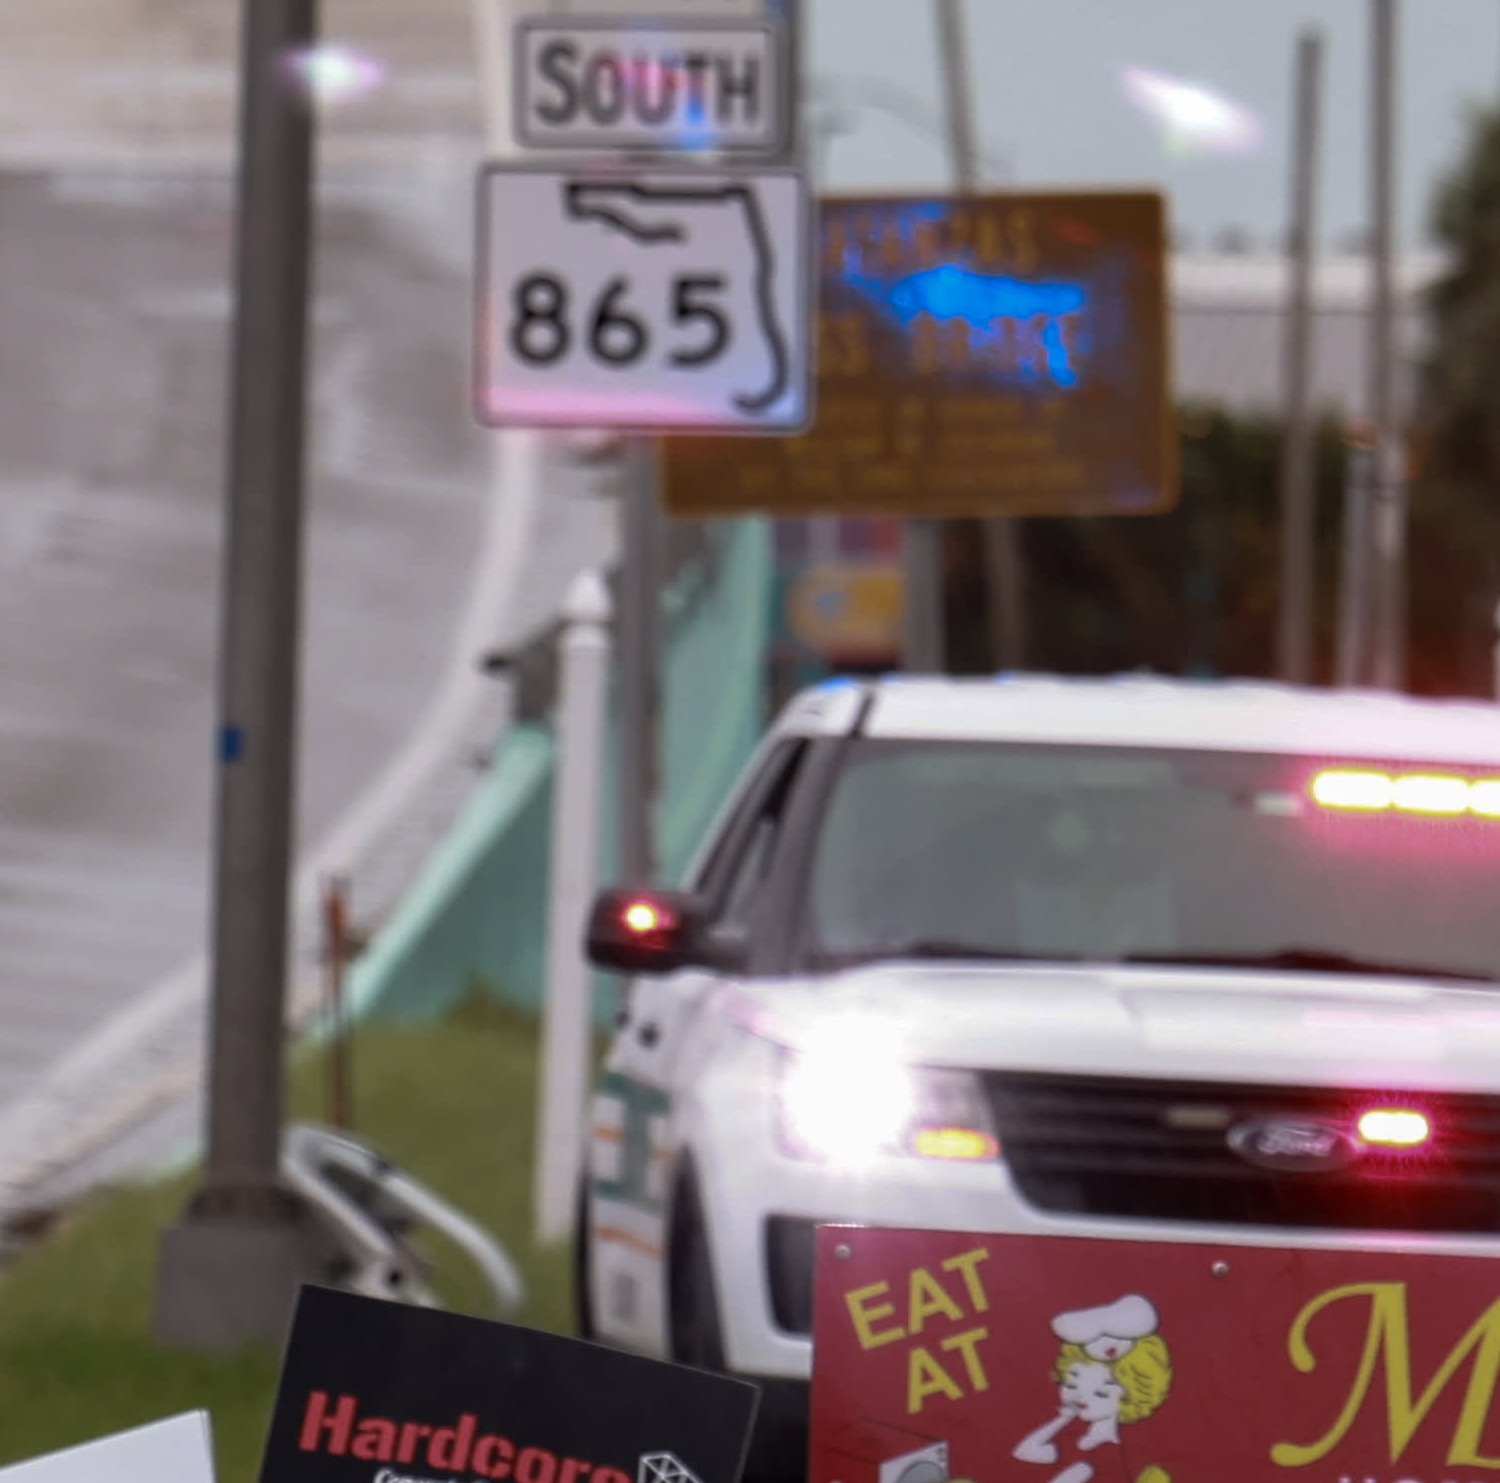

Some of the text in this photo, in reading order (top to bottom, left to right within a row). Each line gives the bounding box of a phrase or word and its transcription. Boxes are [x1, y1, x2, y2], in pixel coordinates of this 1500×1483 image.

[532, 40, 761, 127] SOUTH
[509, 271, 733, 370] 865
[844, 1247, 991, 1351] EAT
[906, 1328, 991, 1414] AT
